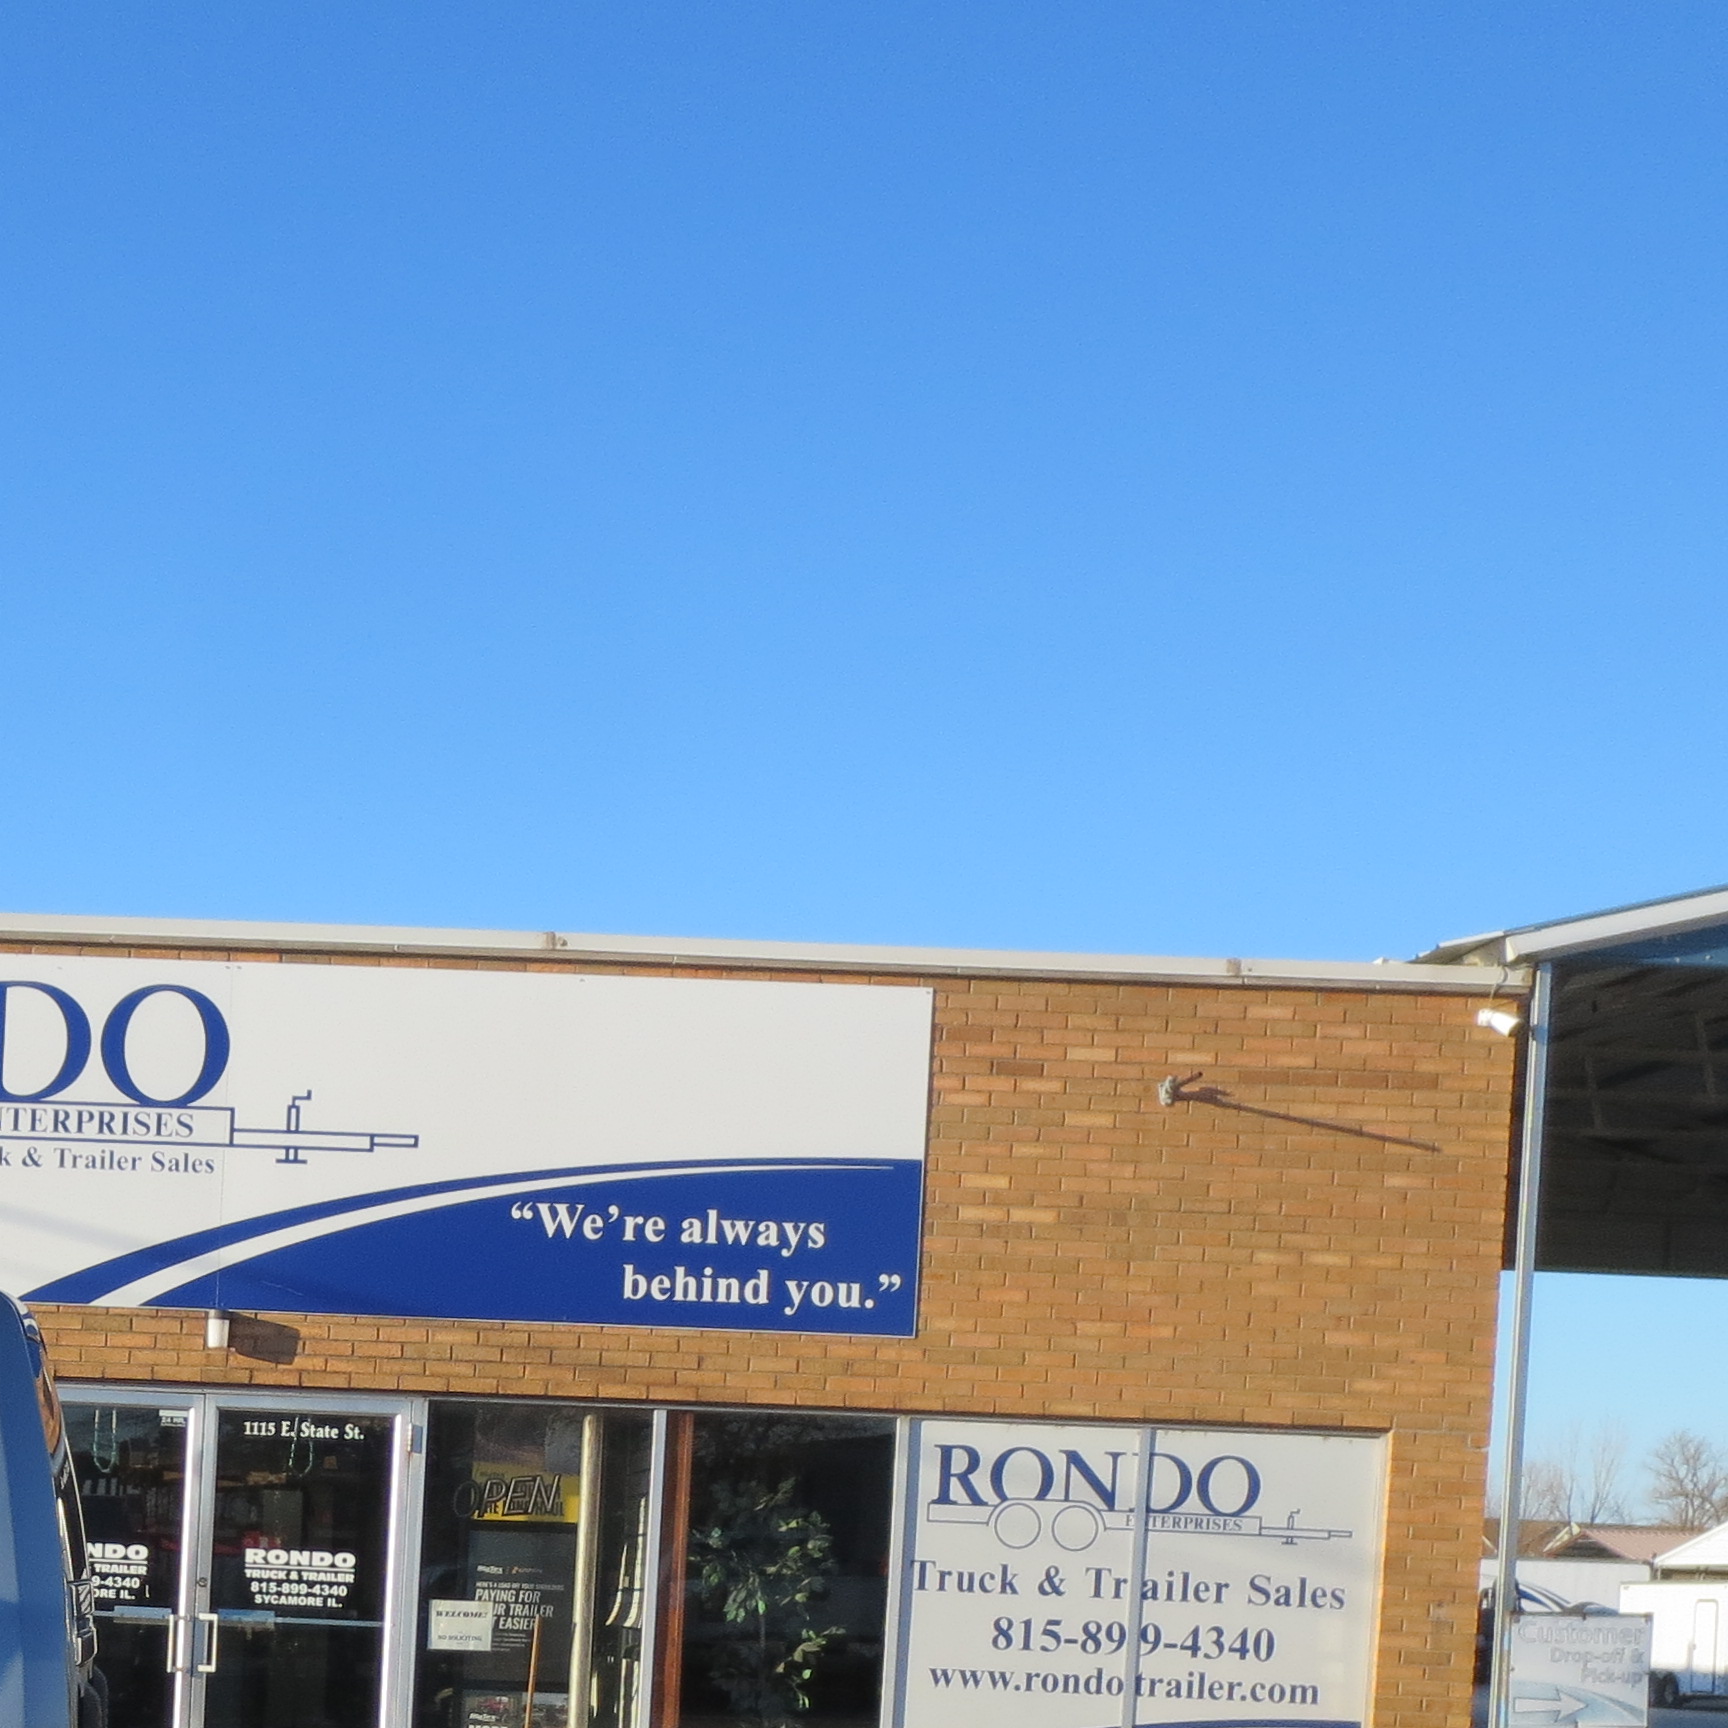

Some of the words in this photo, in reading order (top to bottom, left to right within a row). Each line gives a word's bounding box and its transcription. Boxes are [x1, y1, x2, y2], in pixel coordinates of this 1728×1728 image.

[21, 1146, 42, 1169] &
[53, 1148, 142, 1174] Trailer
[151, 1149, 215, 1176] Sales
[681, 1209, 825, 1256] always
[623, 1264, 769, 1306] behind
[243, 1421, 276, 1436] 1115
[280, 1420, 295, 1437] E.
[300, 1422, 339, 1439] State
[344, 1423, 364, 1440] St.
[929, 1443, 1261, 1517] RONDO
[1125, 1514, 1243, 1533] ETERPRISES
[245, 1548, 356, 1568] RONDO
[94, 1563, 148, 1575] TRAILER
[244, 1569, 287, 1580] TRUCK
[289, 1571, 299, 1581] &
[301, 1572, 355, 1583] TRAILER
[251, 1581, 347, 1597] 815-899-4340
[910, 1559, 1019, 1595] Truck
[1038, 1565, 1065, 1597] &
[1085, 1567, 1229, 1605] Trailer
[1247, 1574, 1345, 1609] Sales
[120, 1590, 135, 1599] IL.
[254, 1594, 323, 1607] SYCAMORE
[327, 1598, 343, 1608] IL.
[475, 1589, 515, 1602] PAYING
[518, 1590, 541, 1603] FOR
[510, 1604, 553, 1617] TRAILER
[992, 1615, 1275, 1662] 815-899-4340
[1518, 1621, 1644, 1645] Customer
[1550, 1648, 1625, 1667] Drop-off
[929, 1667, 1319, 1706] www.rondotrailer.com
[1580, 1666, 1643, 1687] Pick-up
